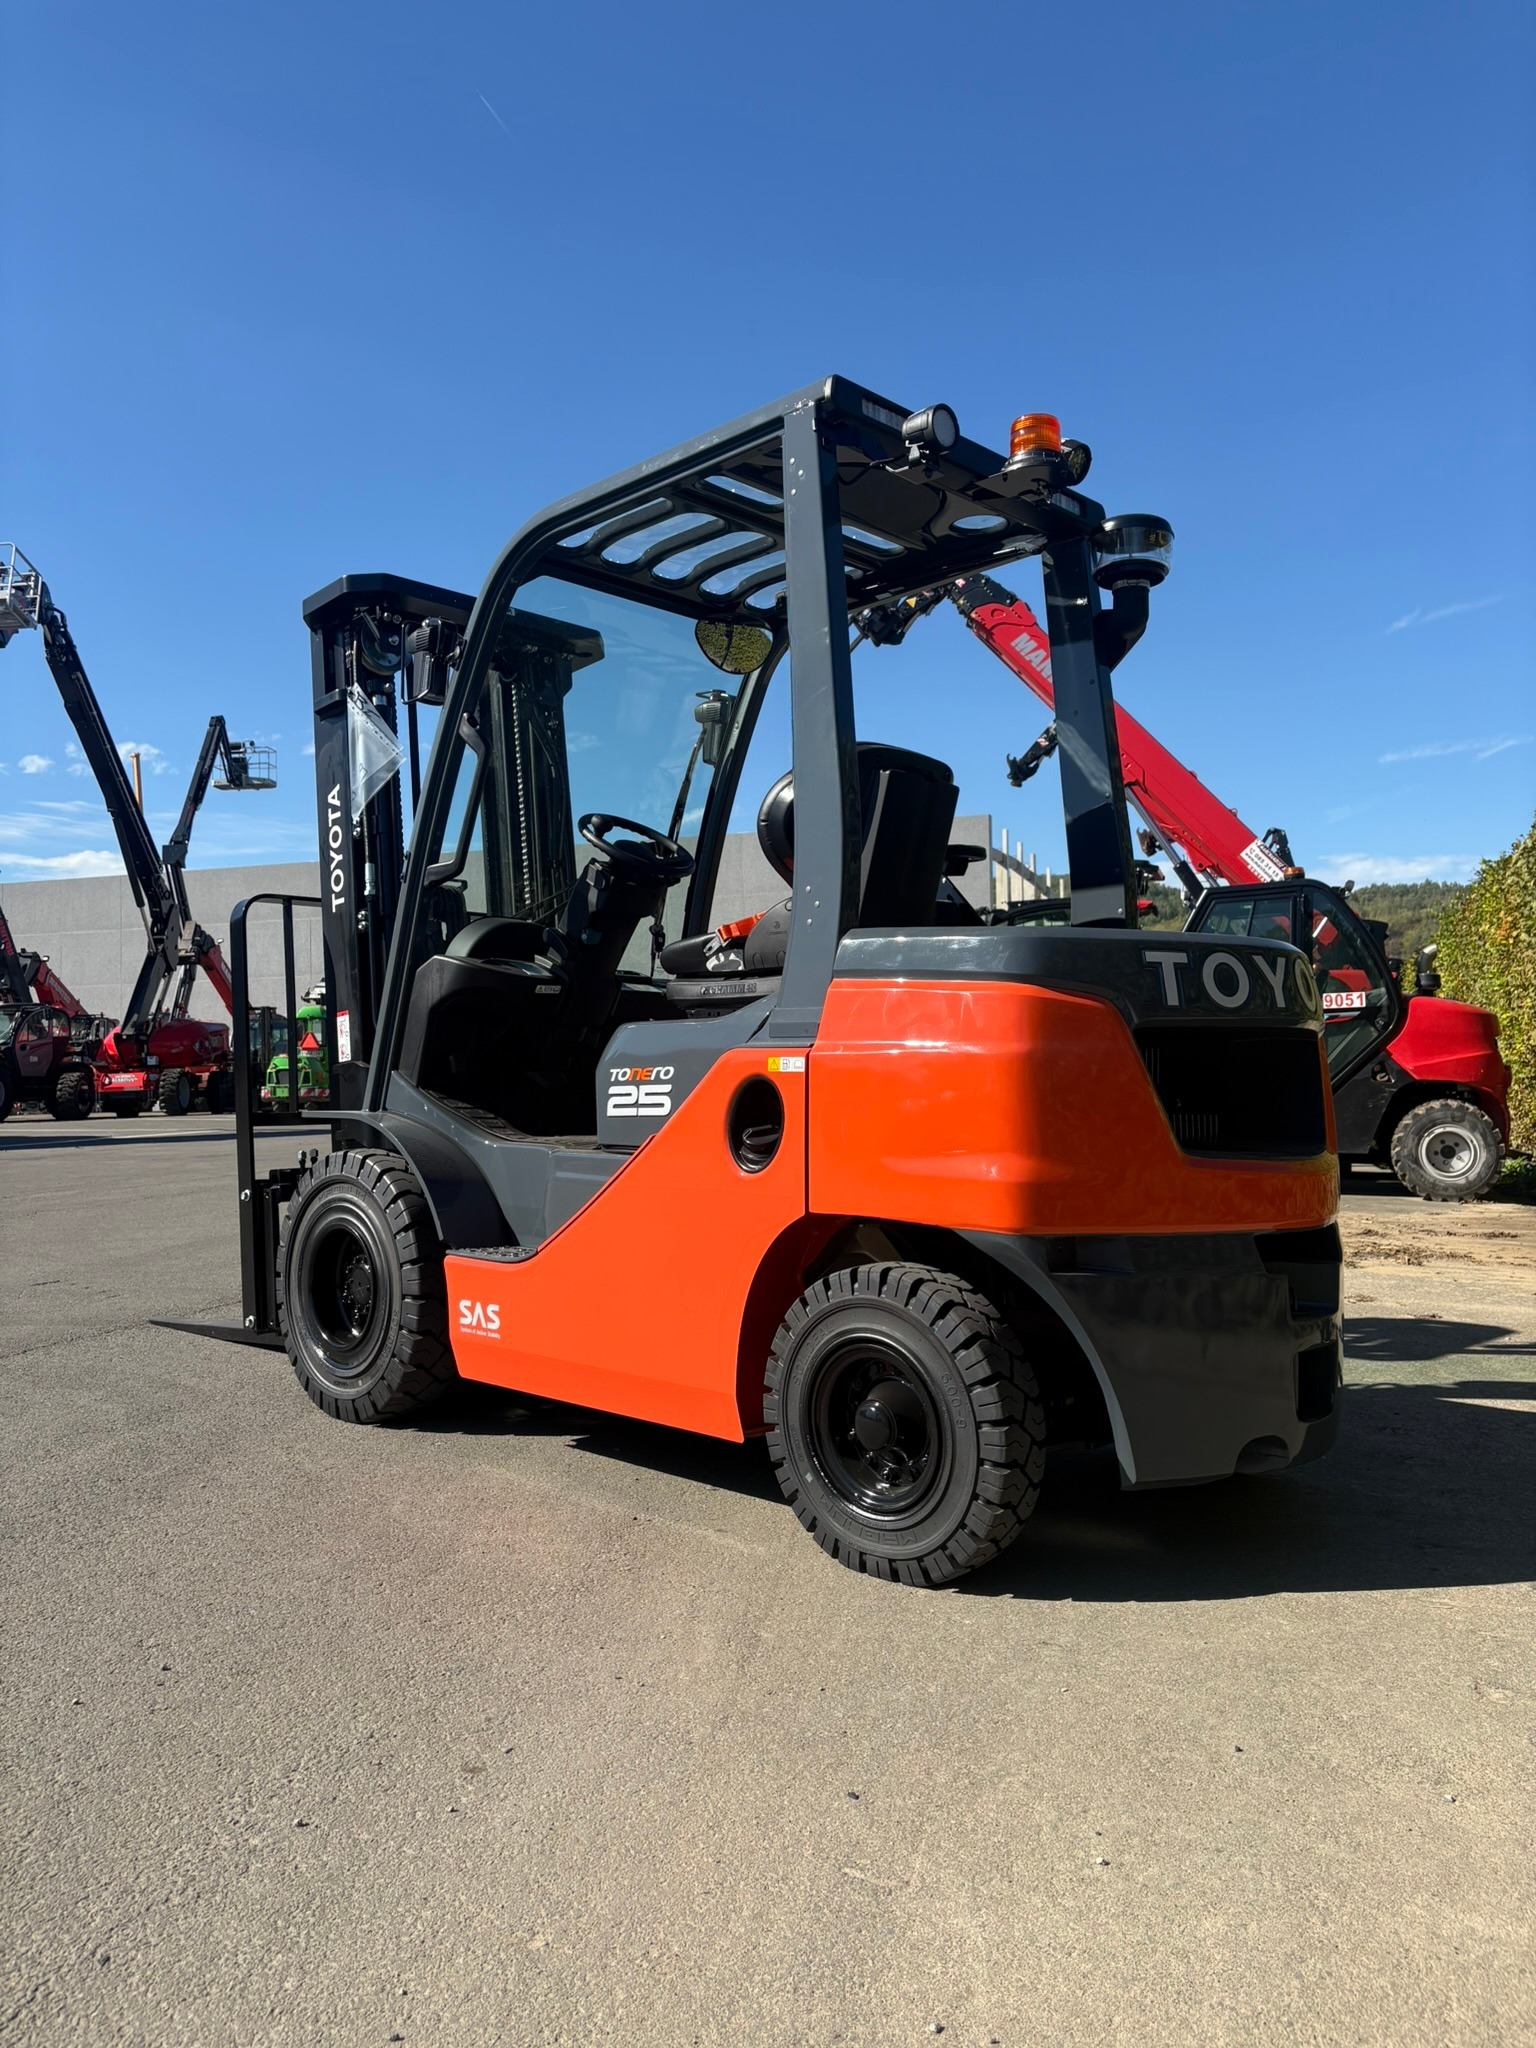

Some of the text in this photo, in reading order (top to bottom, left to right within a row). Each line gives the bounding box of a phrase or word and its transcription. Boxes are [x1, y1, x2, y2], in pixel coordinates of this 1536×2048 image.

[327, 783, 345, 913] TOYOTA
[1324, 993, 1364, 1008] 9051
[606, 1084, 672, 1117] 25
[459, 1299, 501, 1330] SAS
